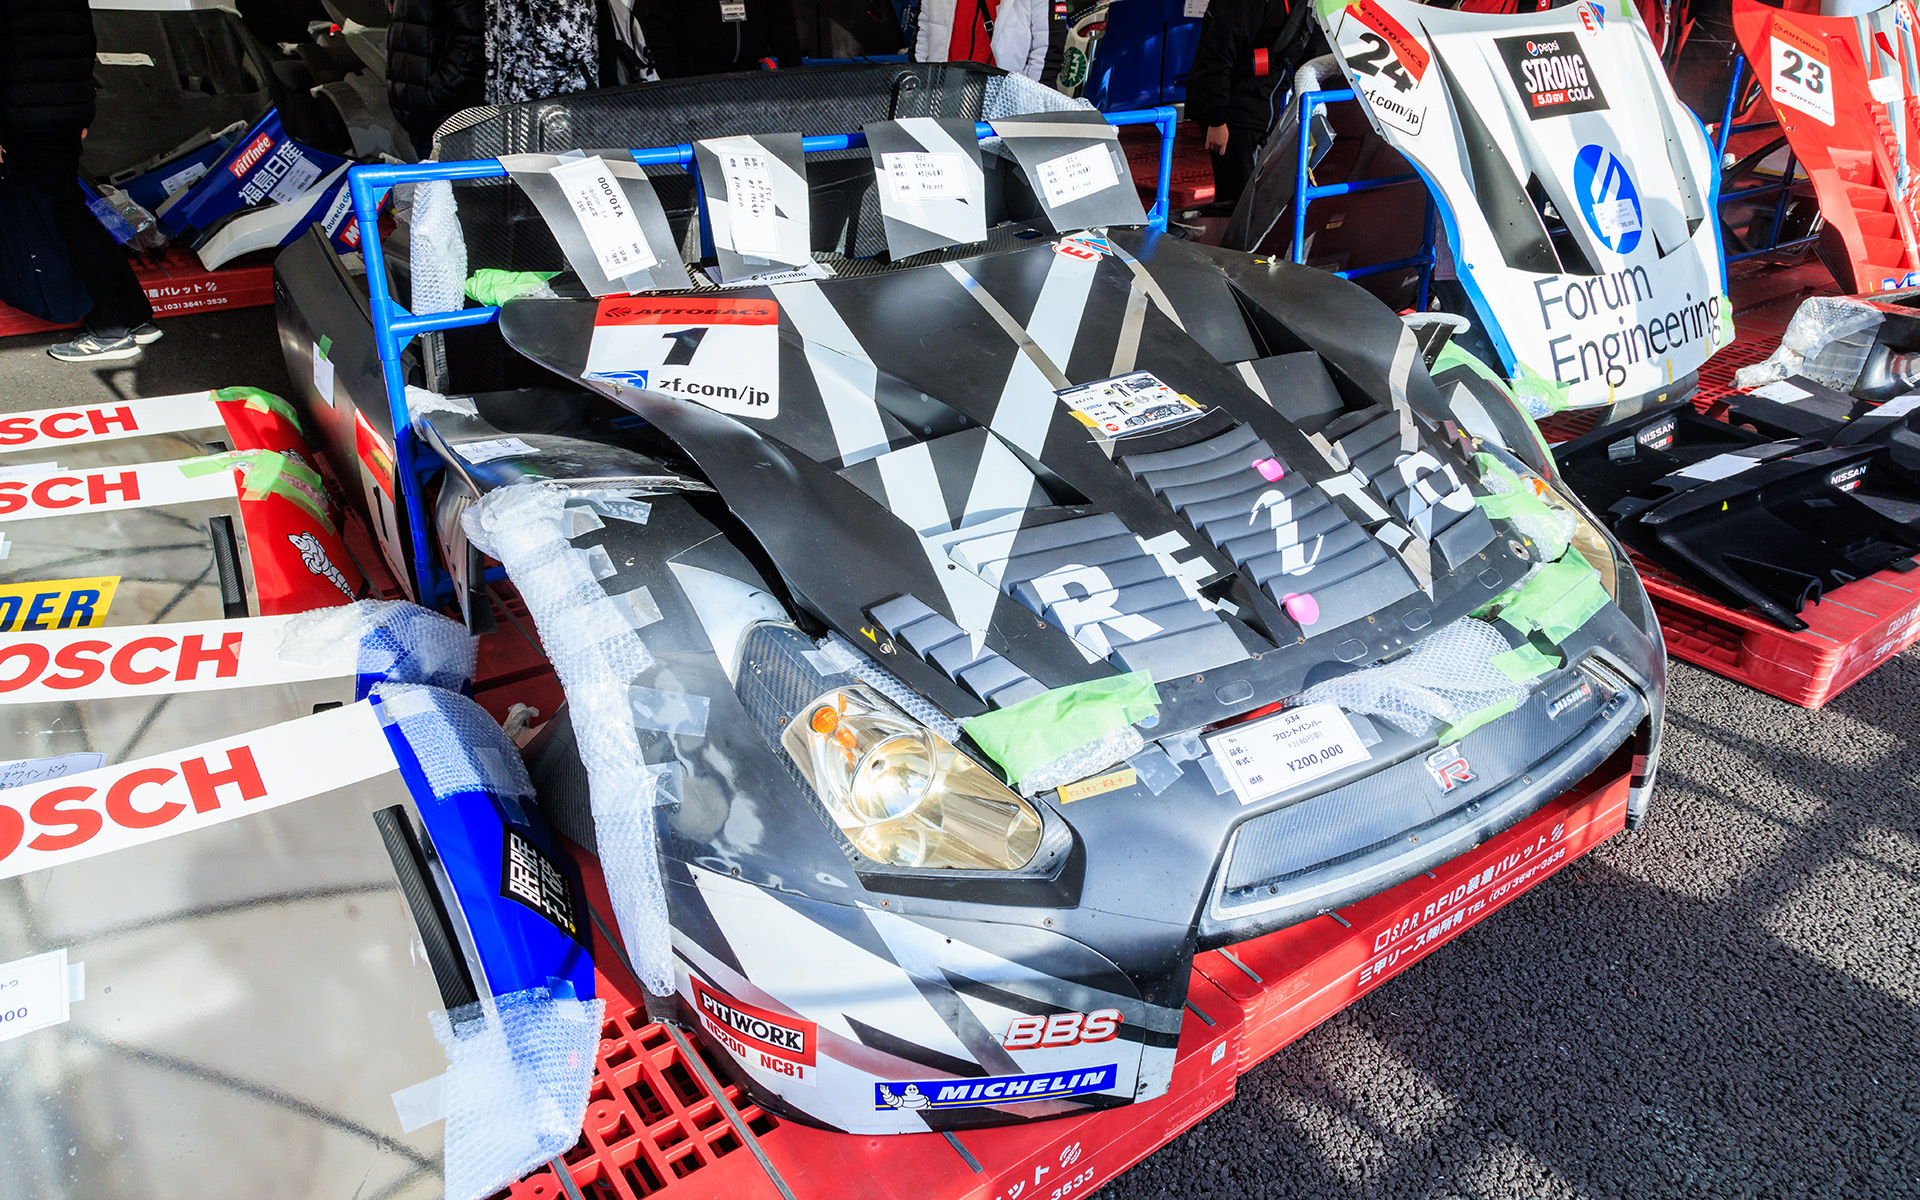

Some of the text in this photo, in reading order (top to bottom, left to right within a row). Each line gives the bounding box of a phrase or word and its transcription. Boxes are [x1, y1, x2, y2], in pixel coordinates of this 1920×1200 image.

[1537, 40, 1560, 54] pepsi
[1068, 53, 1080, 82] NTK
[1345, 32, 1413, 94] 24
[1521, 54, 1589, 94] STRONG
[1780, 50, 1825, 94] 23
[1364, 90, 1419, 124] zf.com/jp
[1567, 87, 1595, 102] COLA
[238, 140, 304, 206] 福島日産
[597, 176, 624, 218] ¥10,000
[634, 307, 770, 316] AUTOBACS
[1533, 265, 1653, 330] Forum
[662, 327, 709, 366] 1
[1549, 293, 1720, 389] Engineering
[659, 378, 770, 407] zf.com/jp
[1640, 422, 1674, 444] NISSAN
[1831, 466, 1867, 484] NISSAN
[1272, 719, 1323, 742] フロントバンパー
[1284, 714, 1300, 725] 534
[1285, 744, 1344, 772] ¥200,000
[1467, 898, 1486, 917] TEL
[1002, 1009, 1125, 1051] BBS
[706, 1018, 804, 1080] NC200 NC81
[937, 1070, 1106, 1101] MICHELIN
